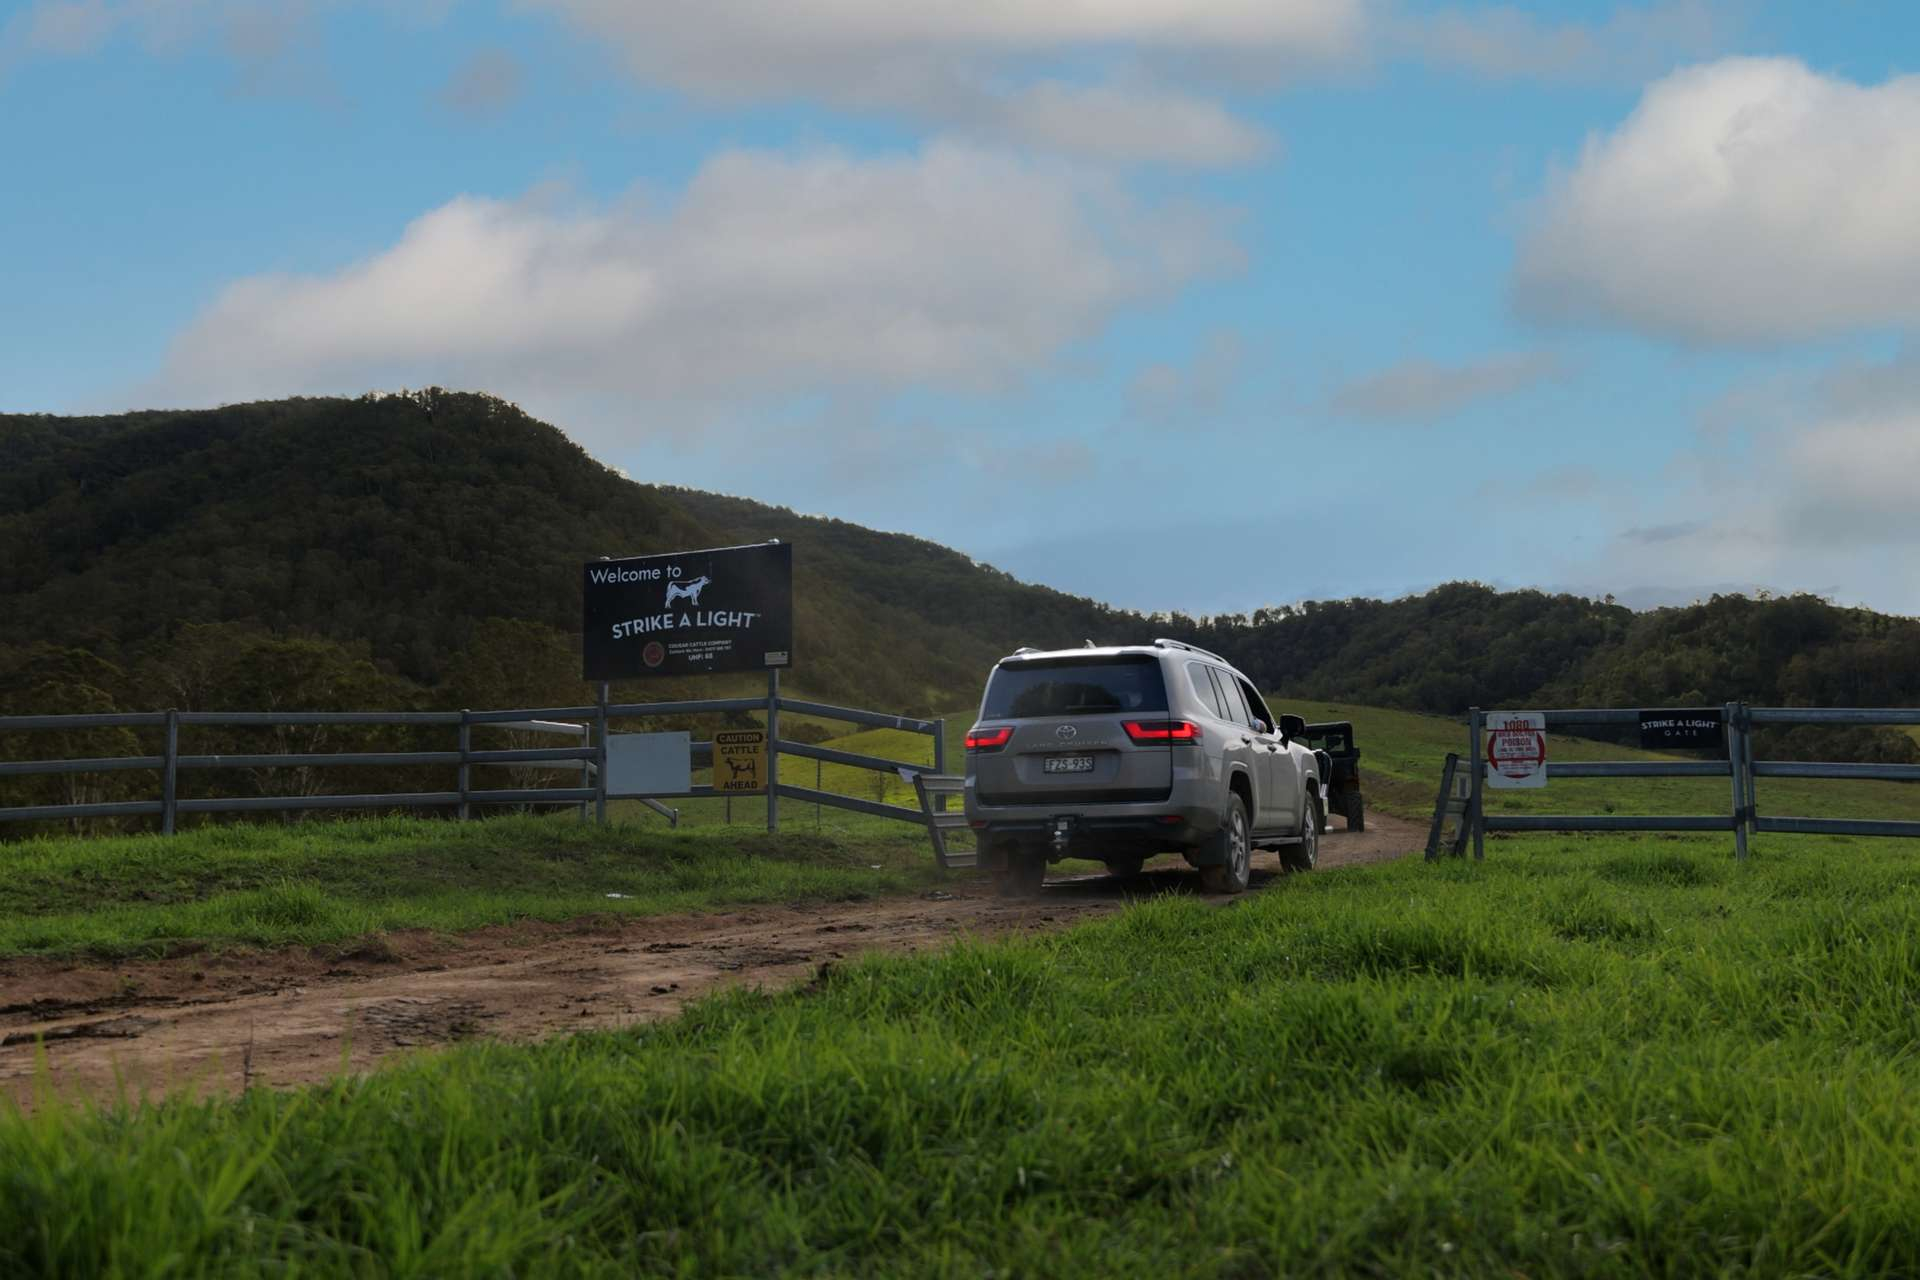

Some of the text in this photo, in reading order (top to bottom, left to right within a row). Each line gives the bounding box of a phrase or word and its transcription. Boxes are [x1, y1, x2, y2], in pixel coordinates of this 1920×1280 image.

[590, 564, 682, 584] Welcome to
[612, 611, 755, 639] STRIKE A LIGHT
[1641, 720, 1675, 729] STRIKE
[1685, 720, 1717, 728] LIGHT
[719, 733, 760, 743] CAUTION
[1502, 737, 1532, 746] POISON
[720, 746, 759, 755] CATTLE
[723, 780, 758, 789] AHEAD
